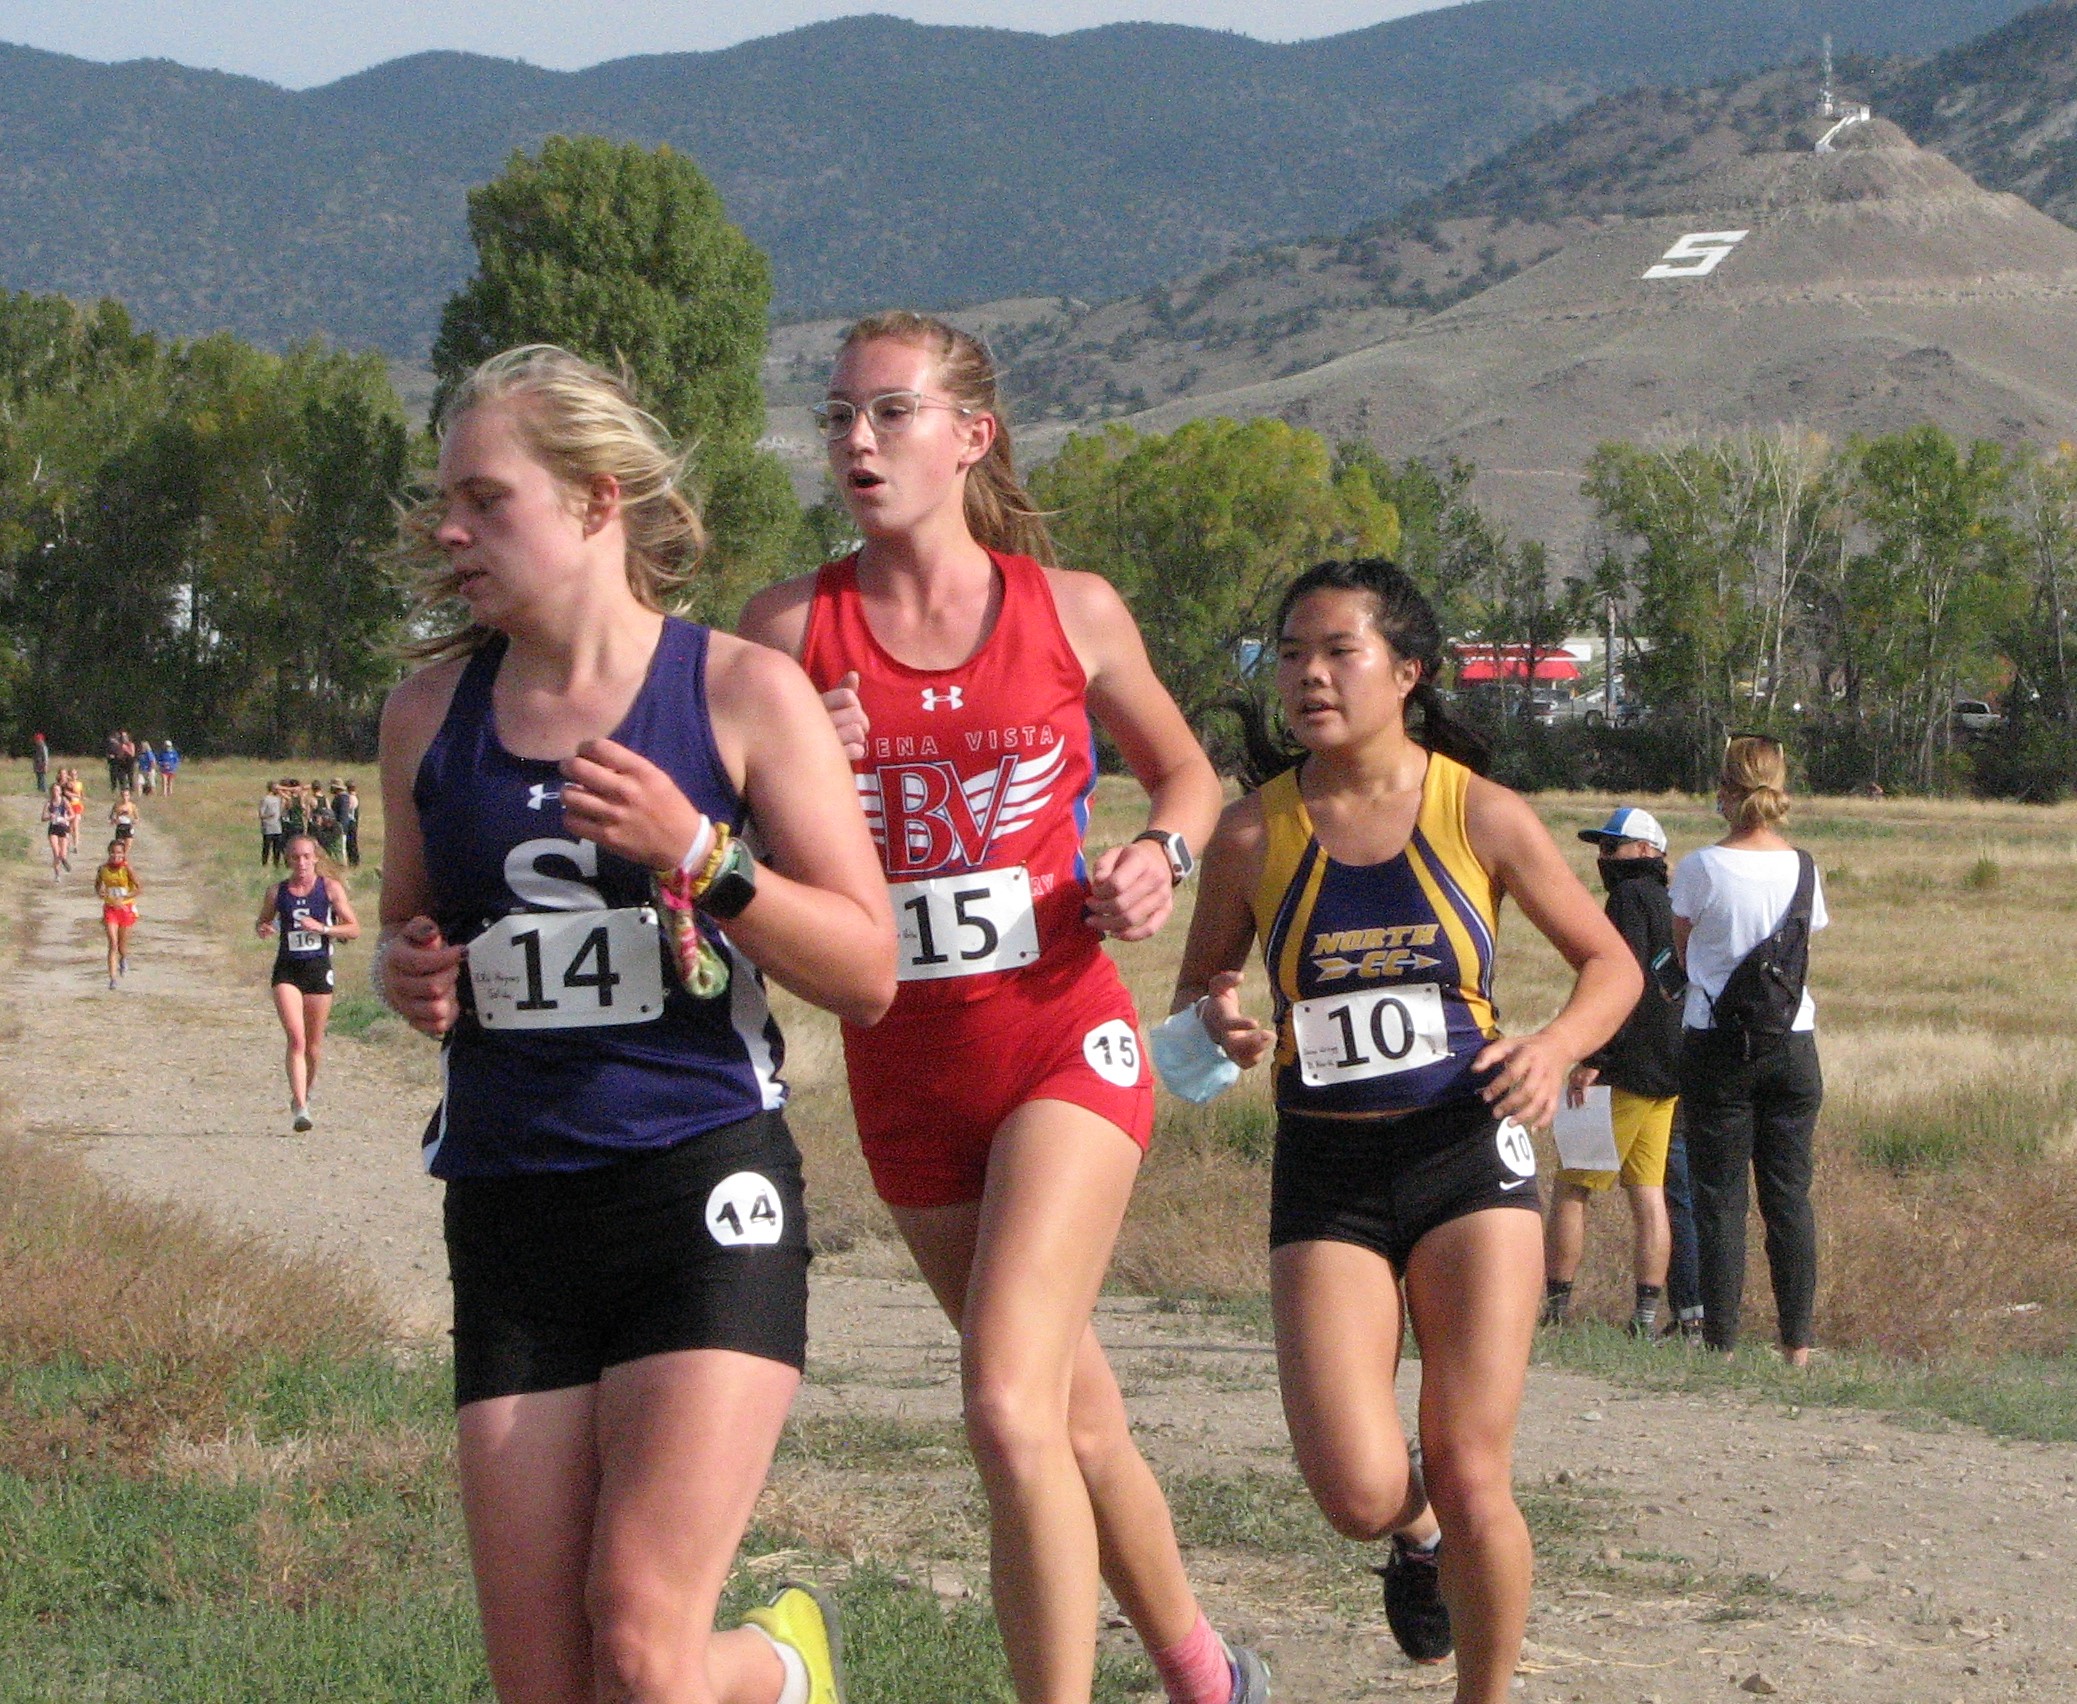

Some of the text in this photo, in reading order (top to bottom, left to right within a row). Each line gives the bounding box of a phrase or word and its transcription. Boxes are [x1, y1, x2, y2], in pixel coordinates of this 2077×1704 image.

[1641, 230, 1750, 279] S
[965, 725, 1054, 751] VISTA
[876, 754, 1019, 874] BV
[504, 837, 608, 913] S
[904, 887, 998, 966] 15
[1309, 923, 1440, 957] NORTH
[511, 926, 620, 1010] 14
[1358, 948, 1412, 978] CC
[1092, 1035, 1135, 1068] 15
[1327, 997, 1415, 1069] 10
[1505, 1133, 1530, 1162] 10
[715, 1188, 776, 1236] 14
